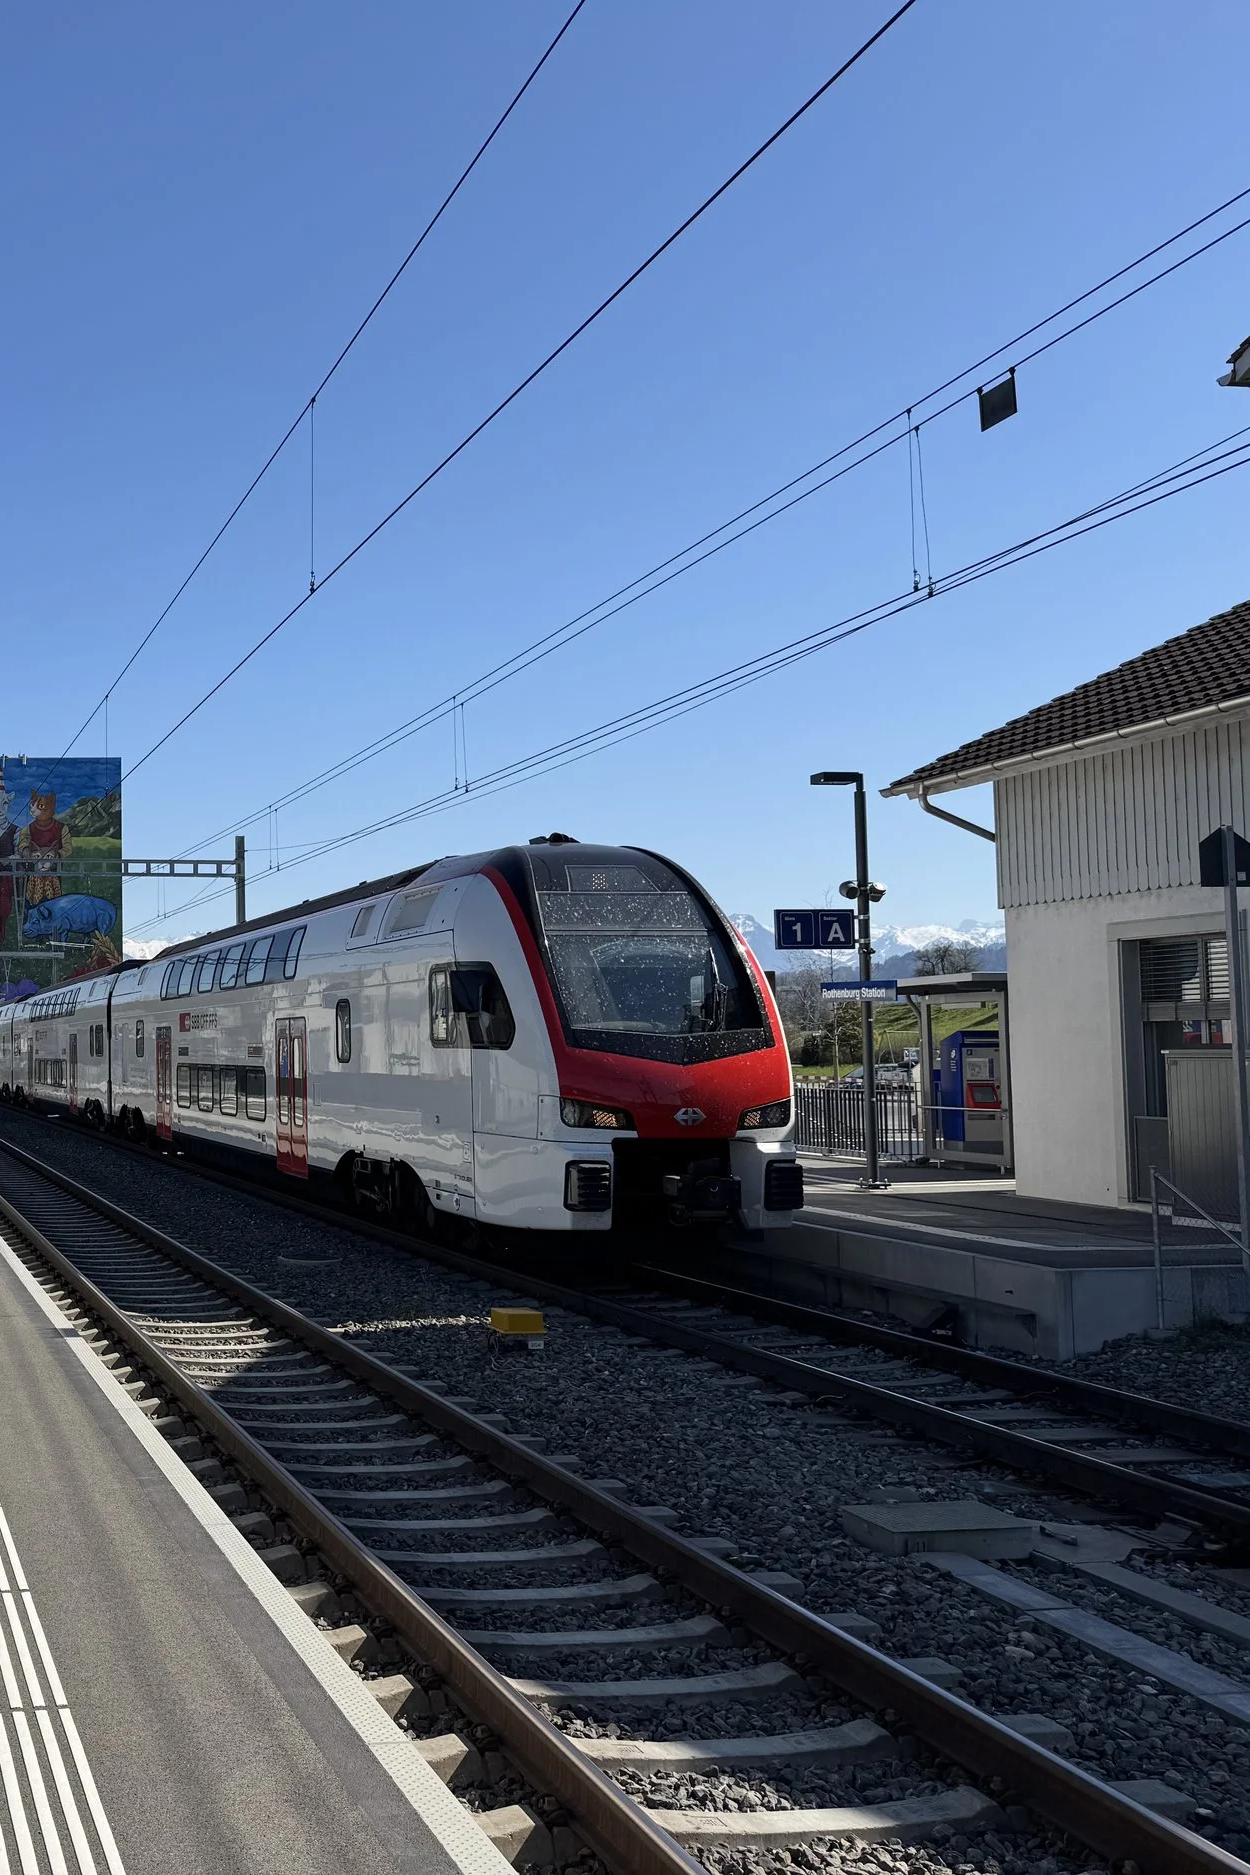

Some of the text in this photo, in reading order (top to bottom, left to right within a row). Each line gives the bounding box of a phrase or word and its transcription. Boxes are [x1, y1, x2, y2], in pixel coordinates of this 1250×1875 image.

[792, 922, 802, 941] 1
[827, 922, 845, 942] A
[822, 987, 886, 1000] Rothenburg Station
